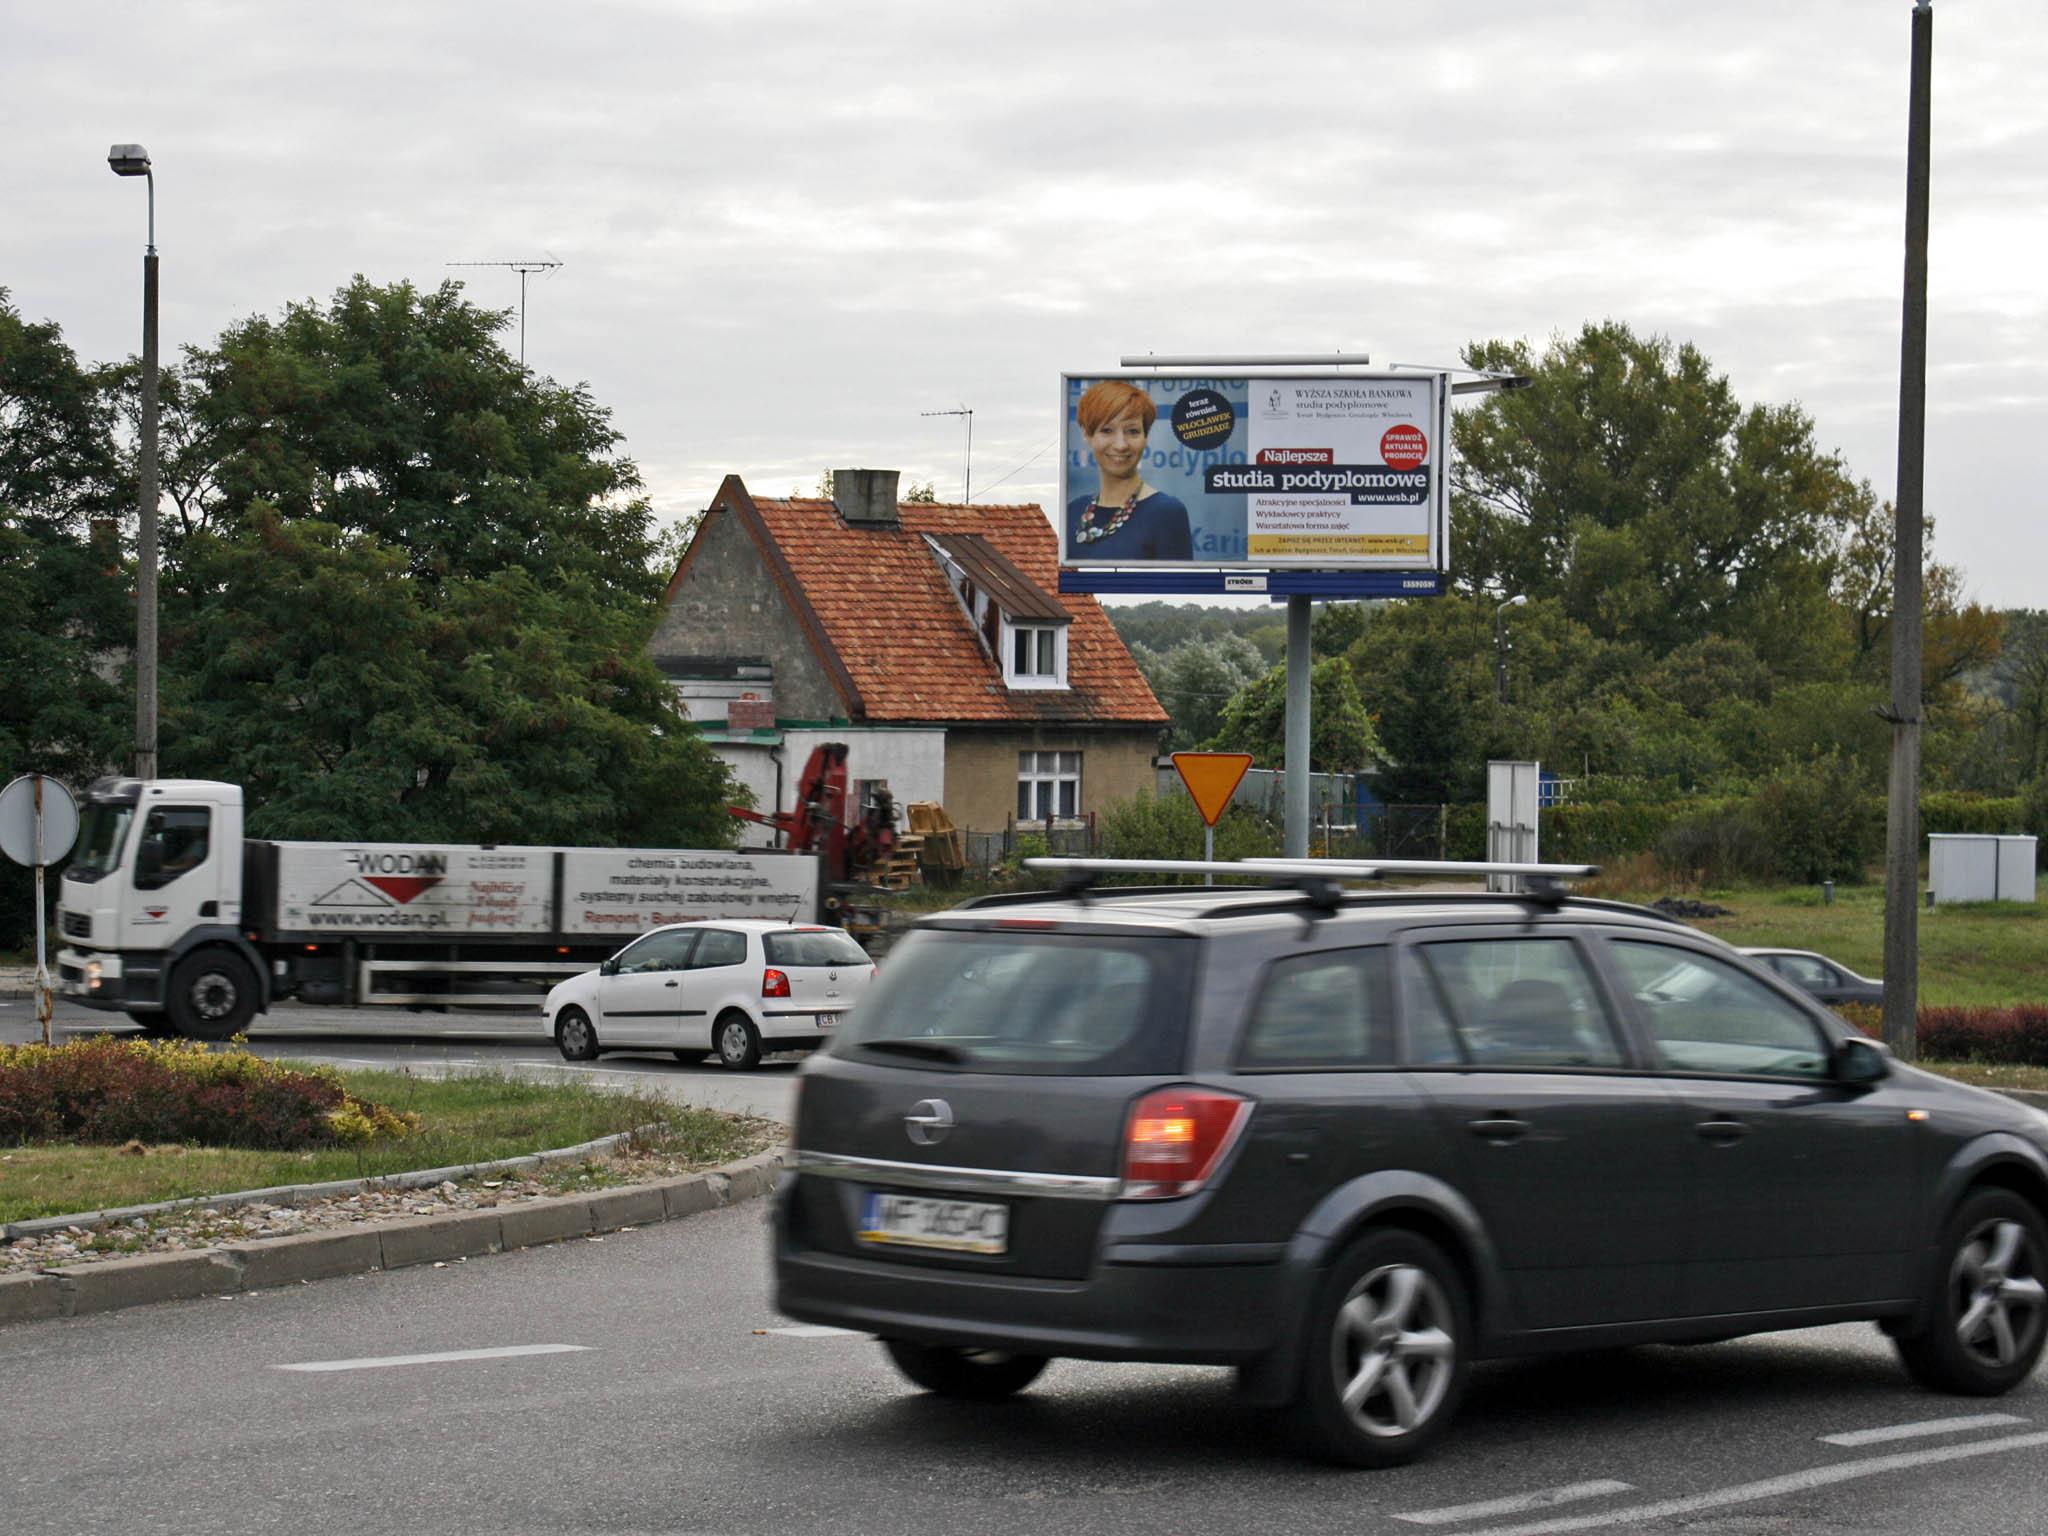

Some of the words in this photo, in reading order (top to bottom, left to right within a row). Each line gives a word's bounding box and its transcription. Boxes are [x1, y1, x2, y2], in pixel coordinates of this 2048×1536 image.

[1296, 388, 1331, 399] WYŻSZA
[1333, 388, 1366, 399] SZKOŁA
[1369, 389, 1412, 399] BANKOWA
[1296, 400, 1323, 409] studia
[1325, 400, 1389, 411] podyplomowe
[1386, 433, 1422, 441] SPRAWDŹ
[1385, 443, 1423, 452] AKTUALNĄ
[1264, 450, 1328, 464] Najlepsze
[1213, 470, 1275, 487] studia
[1281, 470, 1426, 490] podyplomowe
[1256, 498, 1298, 507] Atrakcyjne
[1299, 498, 1346, 507] specjalności
[1358, 493, 1419, 503] www.wsb.pl
[1256, 510, 1305, 519] Wykładowcy
[1306, 510, 1341, 519] praktycy
[1256, 522, 1305, 530] Warsztatowa
[1306, 522, 1329, 530] forma
[358, 854, 447, 875] WODAN
[628, 857, 677, 869] chemia
[680, 857, 756, 871] budowlana,
[609, 874, 671, 888] materiały
[675, 875, 772, 889] konstrukcyjne,
[579, 891, 635, 905] systemy
[639, 891, 685, 905] suchej
[687, 892, 753, 906] zabudowy
[308, 912, 449, 928] www.wodan.pl
[584, 910, 640, 923] Remont
